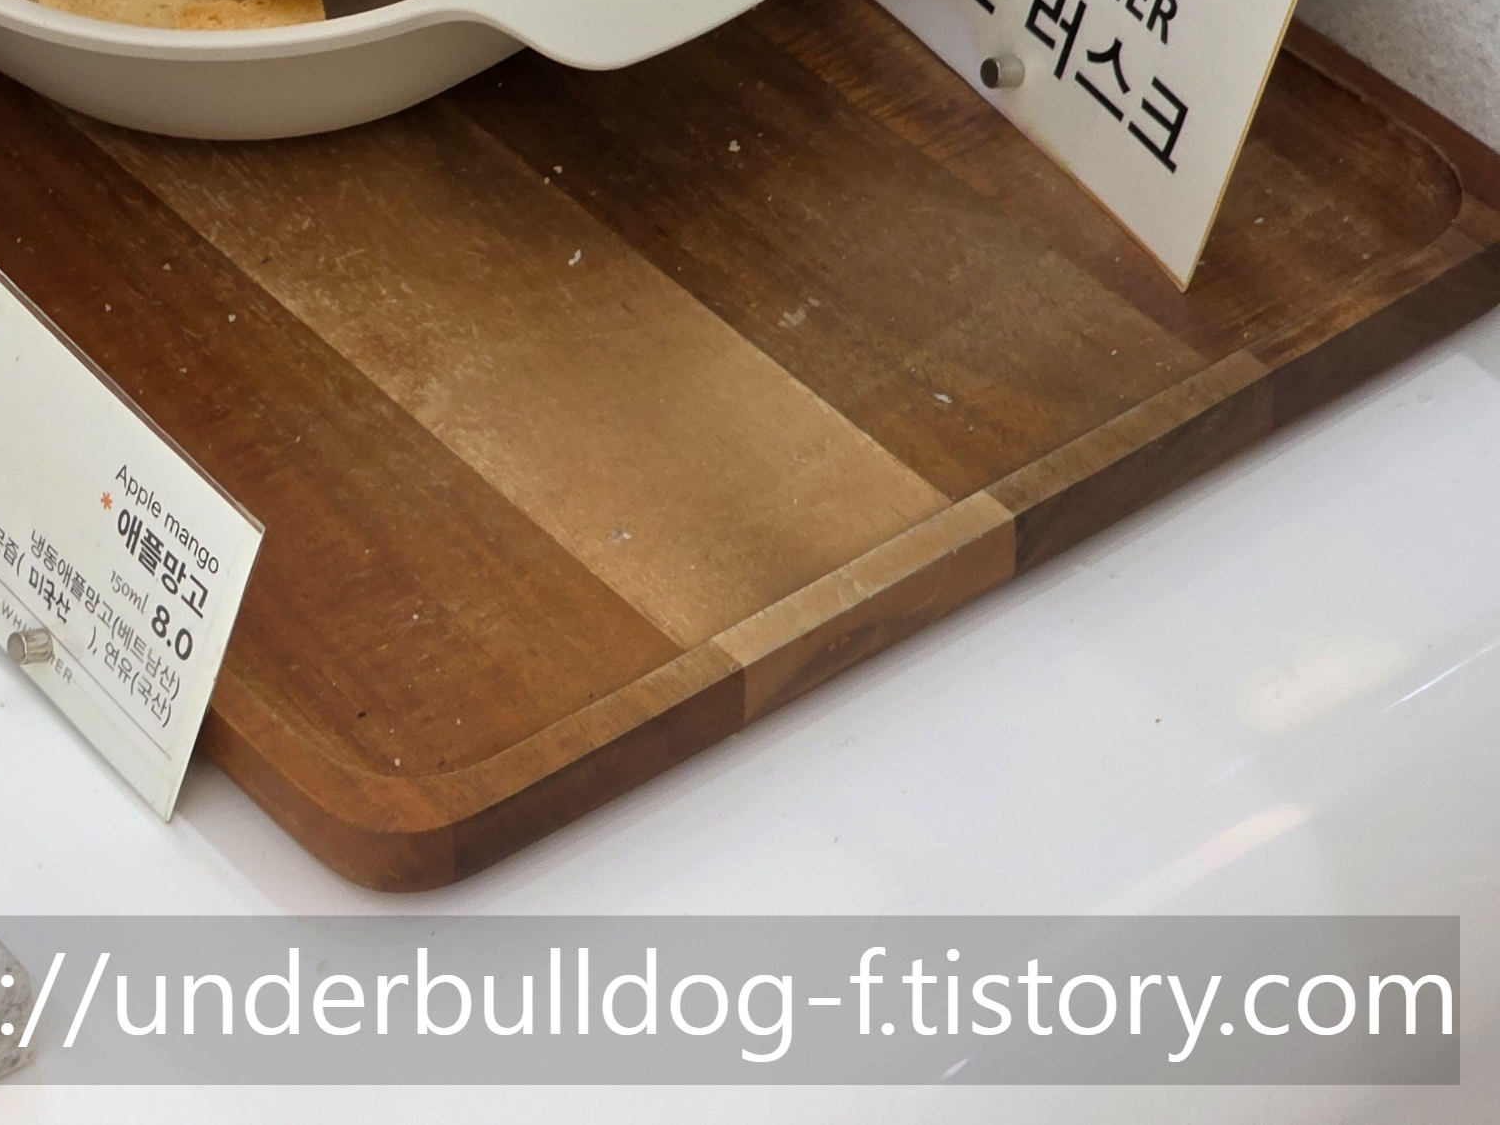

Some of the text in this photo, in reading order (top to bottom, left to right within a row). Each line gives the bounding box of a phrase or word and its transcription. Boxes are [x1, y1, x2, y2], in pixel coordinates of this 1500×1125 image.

[115, 464, 220, 574] Apple mango
[116, 508, 210, 618] 애플망고
[30, 529, 180, 701] 냉동애플망고(베트남산)
[110, 570, 193, 661] 150ml 8.0
[104, 641, 172, 728] 연유(국산)
